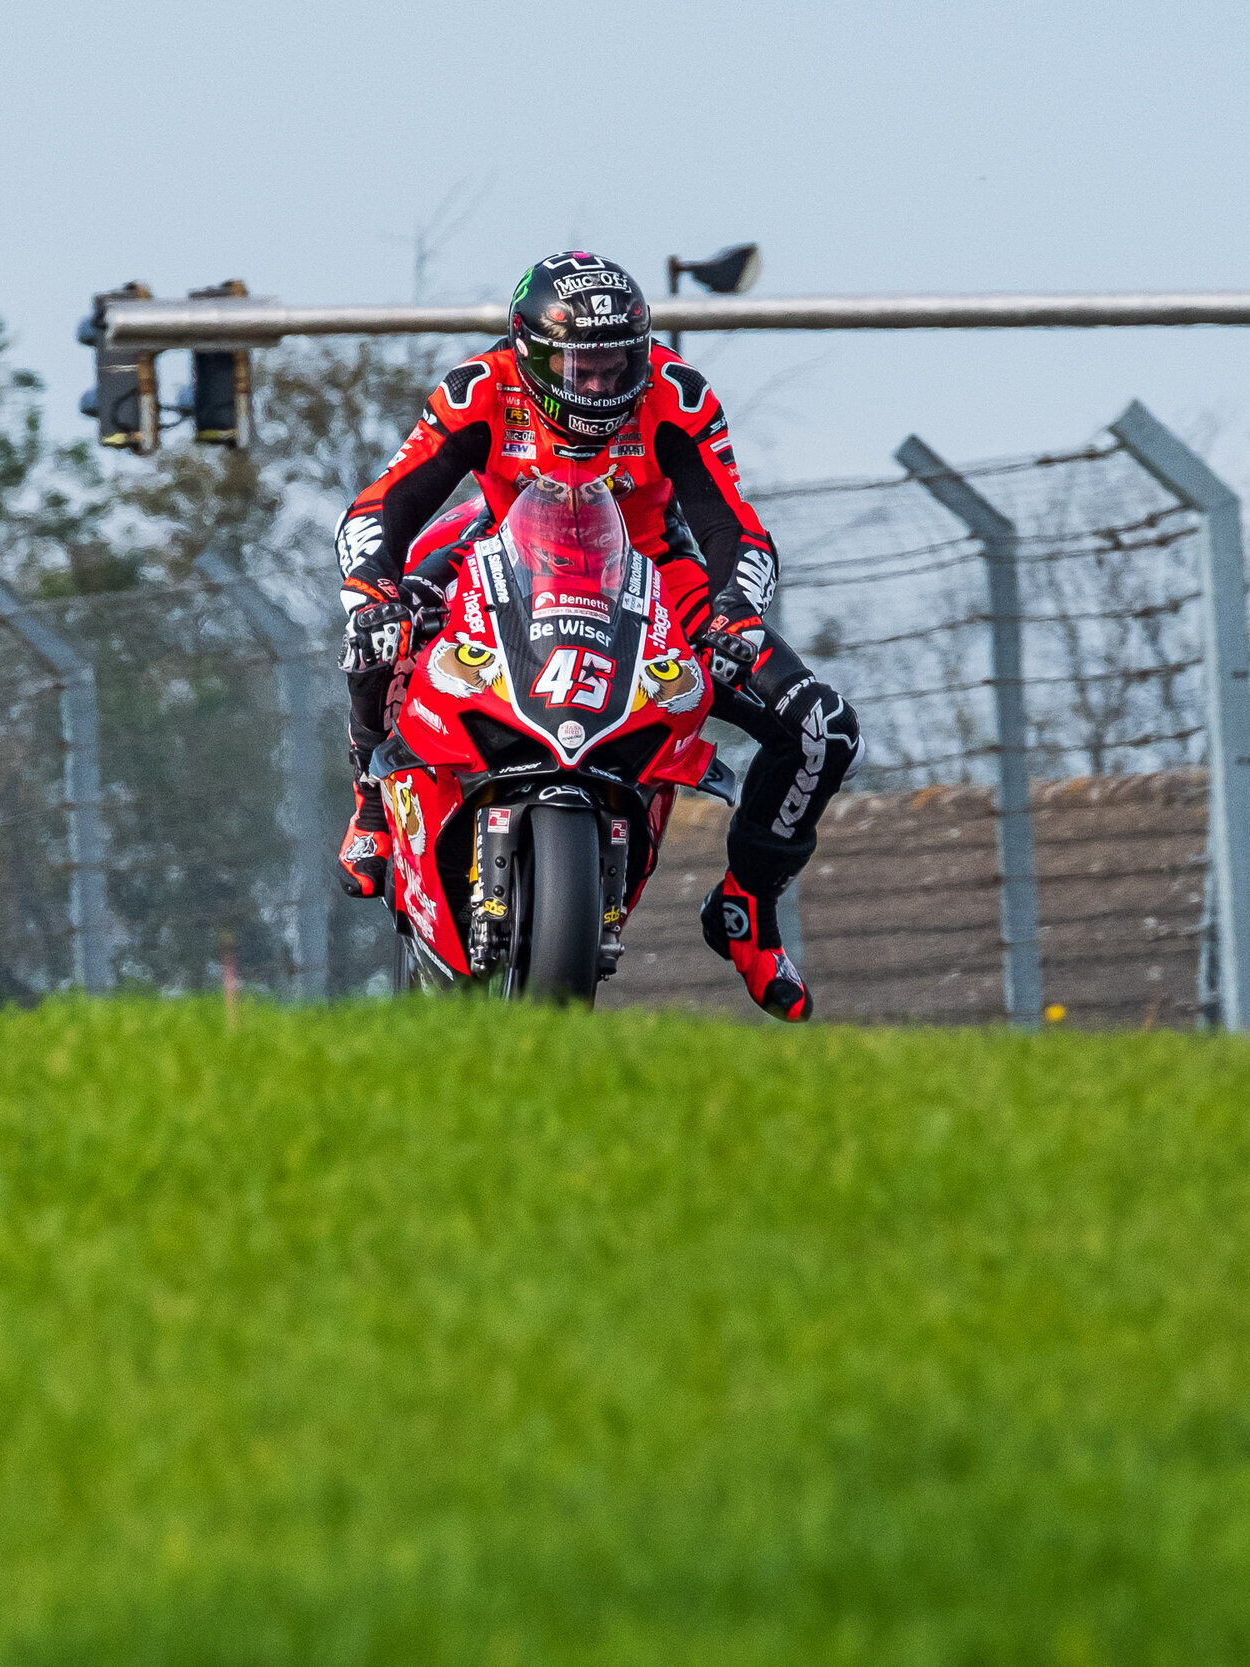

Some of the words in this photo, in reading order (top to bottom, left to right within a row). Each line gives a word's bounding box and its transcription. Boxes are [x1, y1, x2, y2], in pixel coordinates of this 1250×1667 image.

[575, 313, 629, 328] SHARK
[550, 383, 592, 406] WATCHES
[593, 399, 602, 407] of
[502, 443, 529, 453] LEW
[488, 554, 510, 603] Silkolene
[628, 550, 643, 596] Silkolene
[736, 549, 773, 615] MAC
[560, 593, 609, 612] Bennetts
[530, 622, 554, 641] Be
[558, 619, 612, 648] Wiser
[648, 601, 671, 649] :hager
[530, 646, 616, 713] 45
[483, 898, 507, 916] sbs
